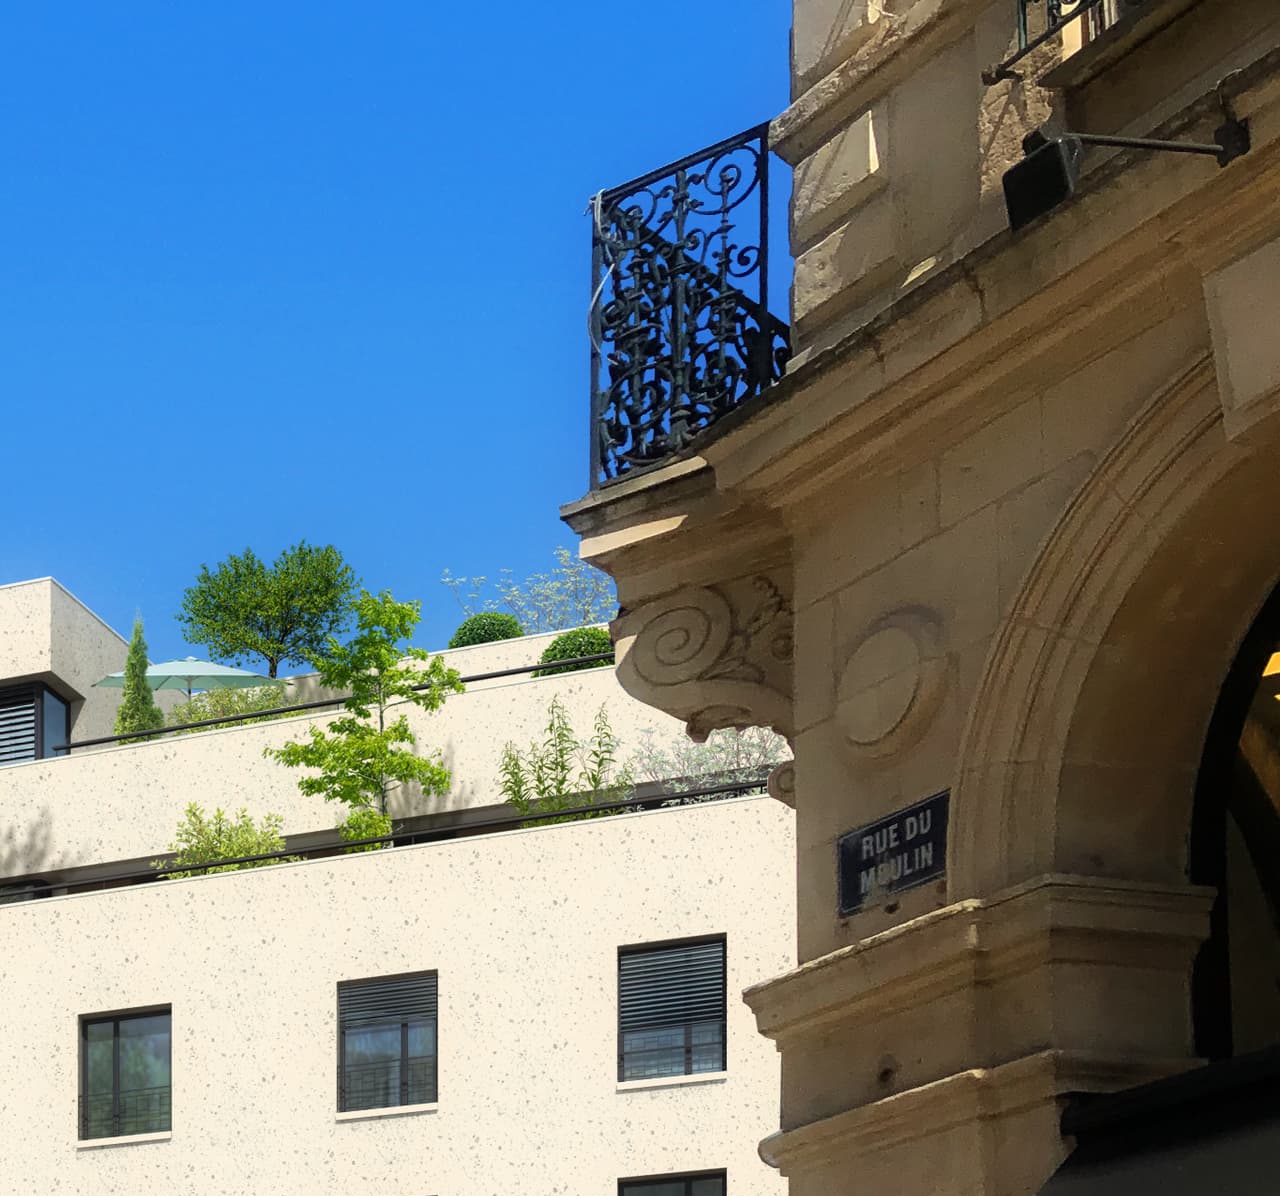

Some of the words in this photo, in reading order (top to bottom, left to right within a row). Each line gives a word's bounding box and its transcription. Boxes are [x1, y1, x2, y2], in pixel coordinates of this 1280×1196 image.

[862, 823, 900, 859] RUE
[905, 809, 932, 841] DU
[860, 842, 933, 894] MOULIN
